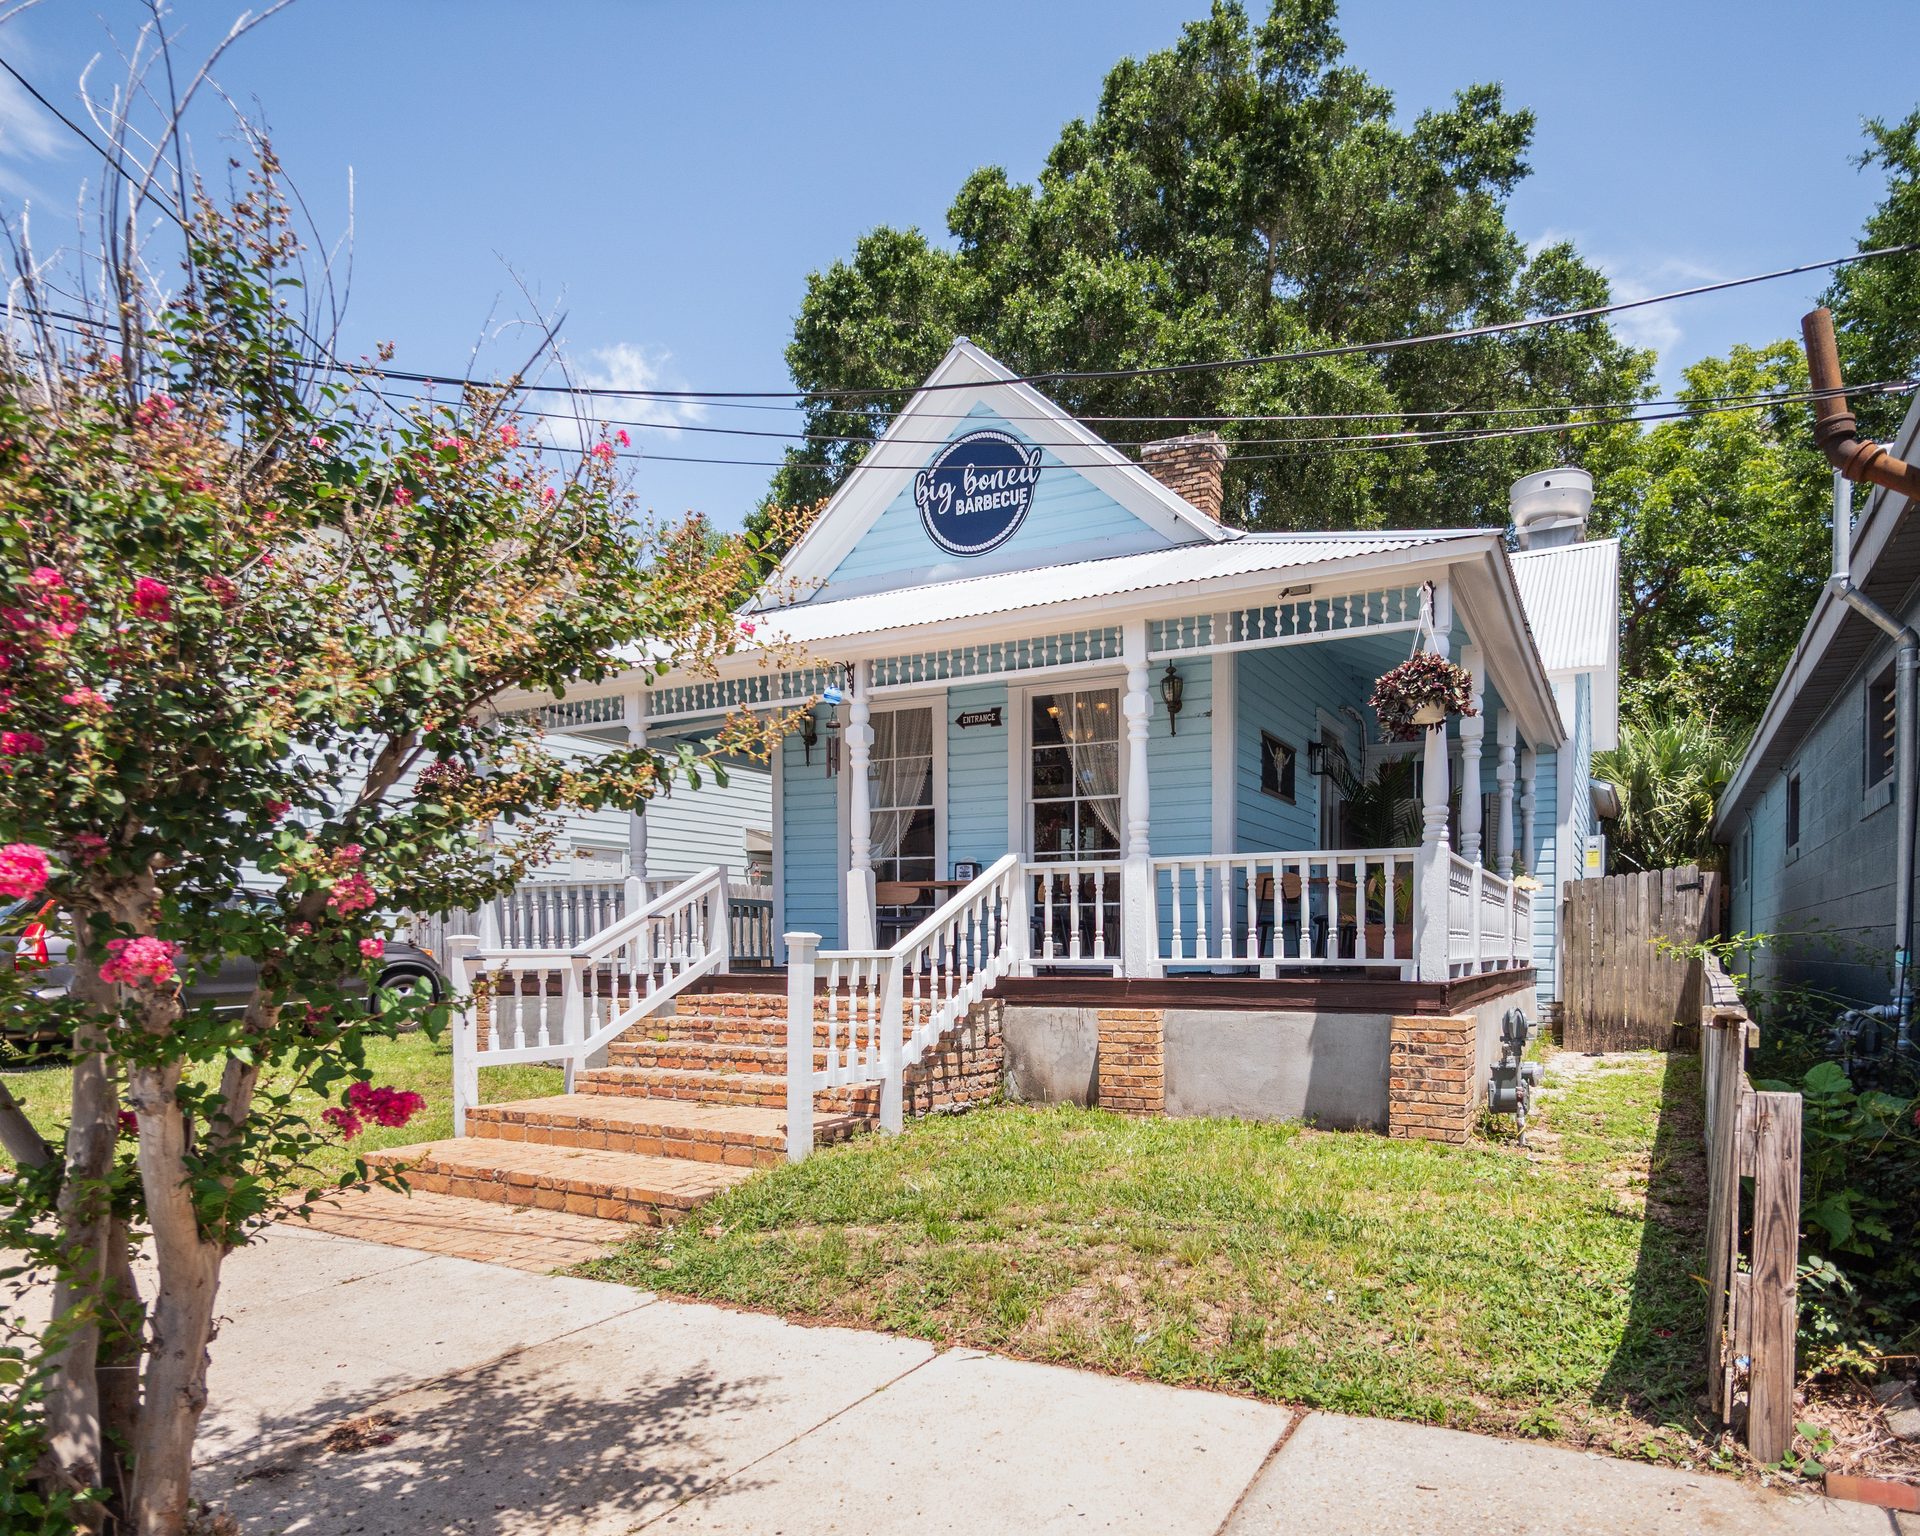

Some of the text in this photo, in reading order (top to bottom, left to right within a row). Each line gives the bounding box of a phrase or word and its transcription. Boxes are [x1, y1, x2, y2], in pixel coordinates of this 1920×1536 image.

[915, 449, 1040, 515] big boned
[955, 487, 1028, 516] BARBECUE
[962, 712, 996, 724] ENTRANCE
